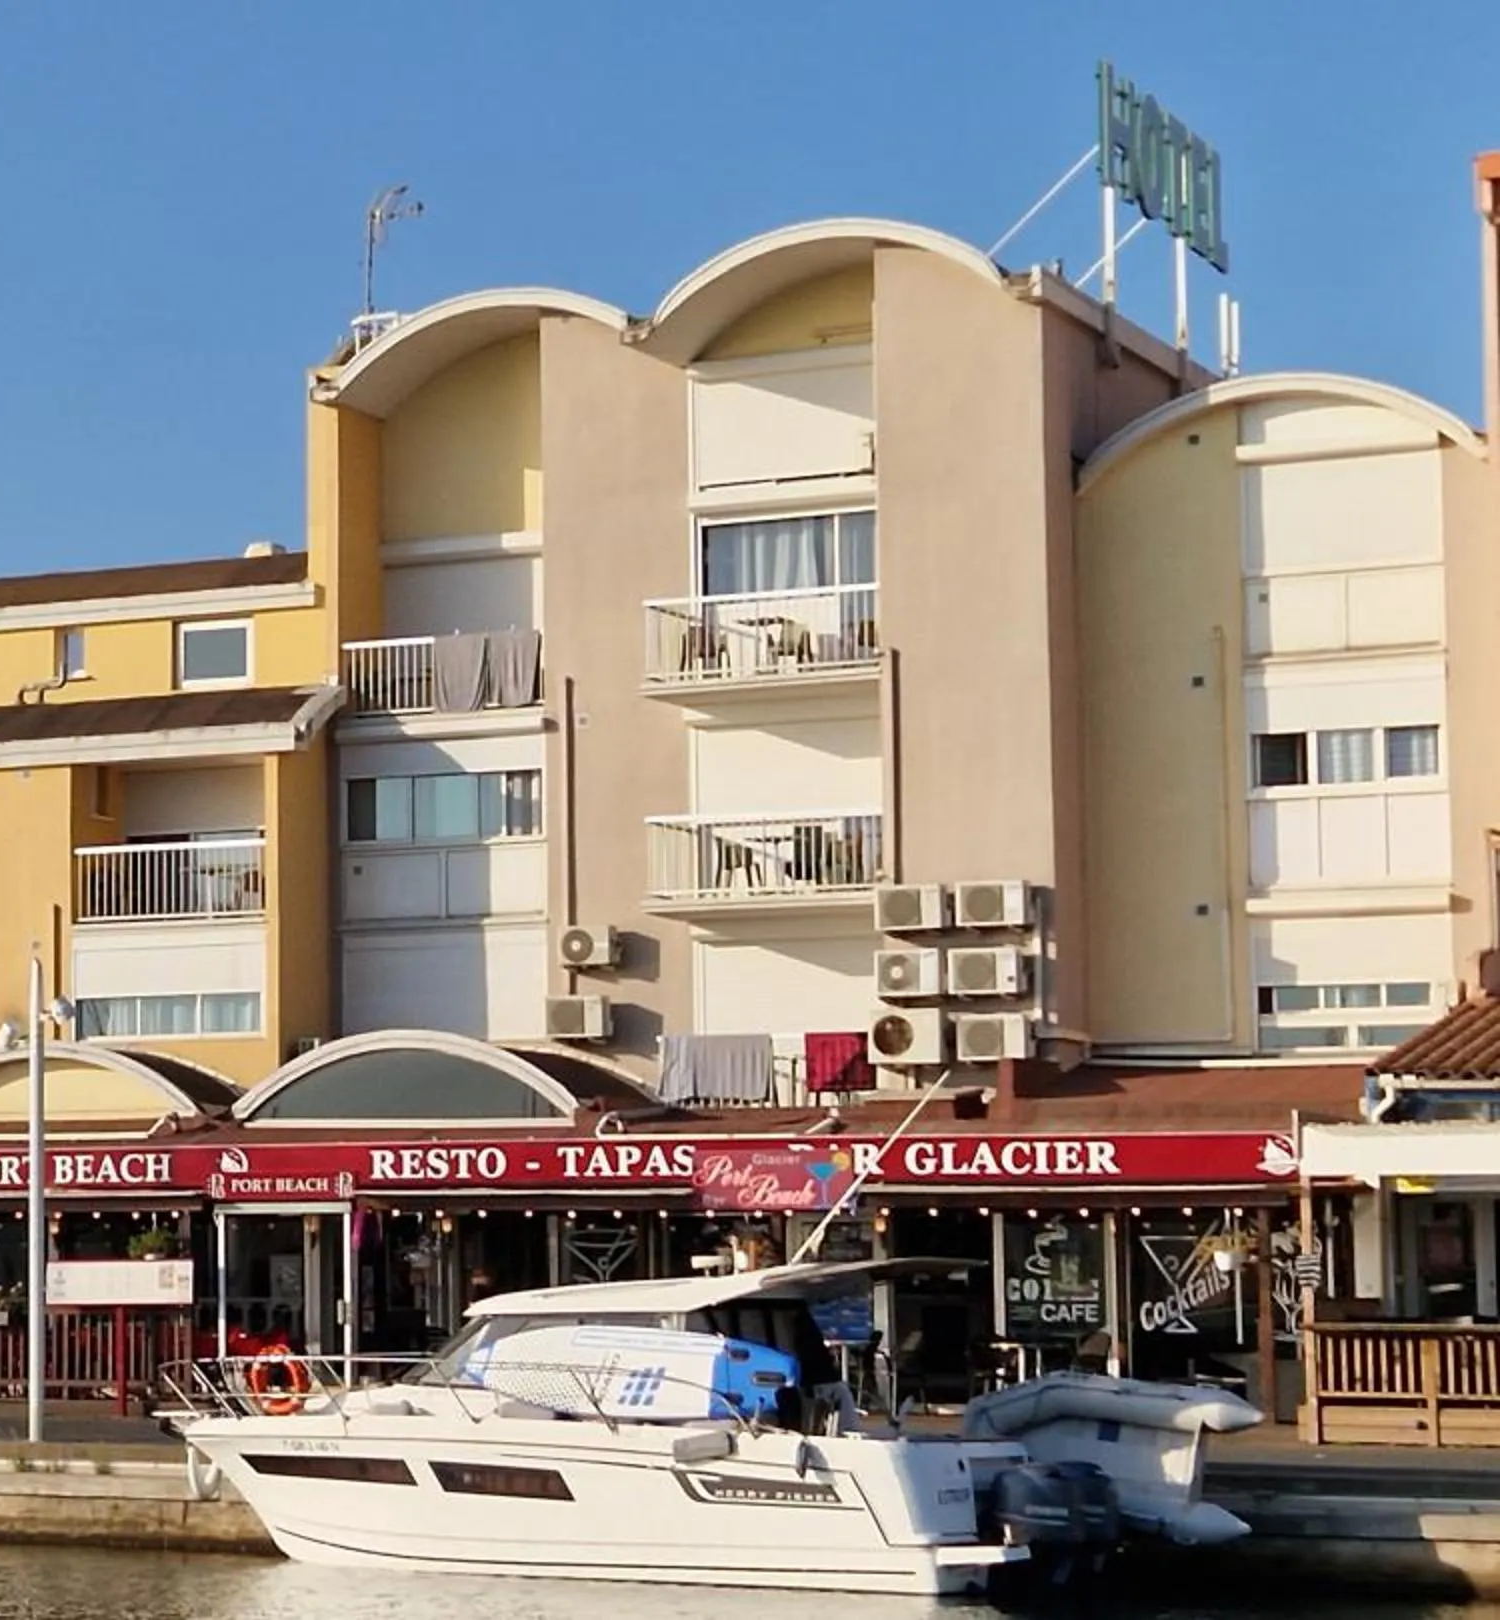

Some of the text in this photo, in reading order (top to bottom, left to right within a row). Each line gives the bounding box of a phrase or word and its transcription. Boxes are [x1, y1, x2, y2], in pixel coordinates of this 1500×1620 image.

[1096, 60, 1229, 274] HOTEL
[52, 1153, 172, 1184] BEACH
[369, 1147, 507, 1180] RESTO
[557, 1145, 696, 1178] TAPAS
[692, 1154, 754, 1187] Port
[751, 1151, 800, 1166] Glacier
[904, 1141, 1122, 1175] GLACIER
[230, 1177, 329, 1193] PORT BEACH
[736, 1173, 818, 1206] Beach
[1040, 1303, 1100, 1322] CAFE
[1140, 1262, 1231, 1332] Cocktails
